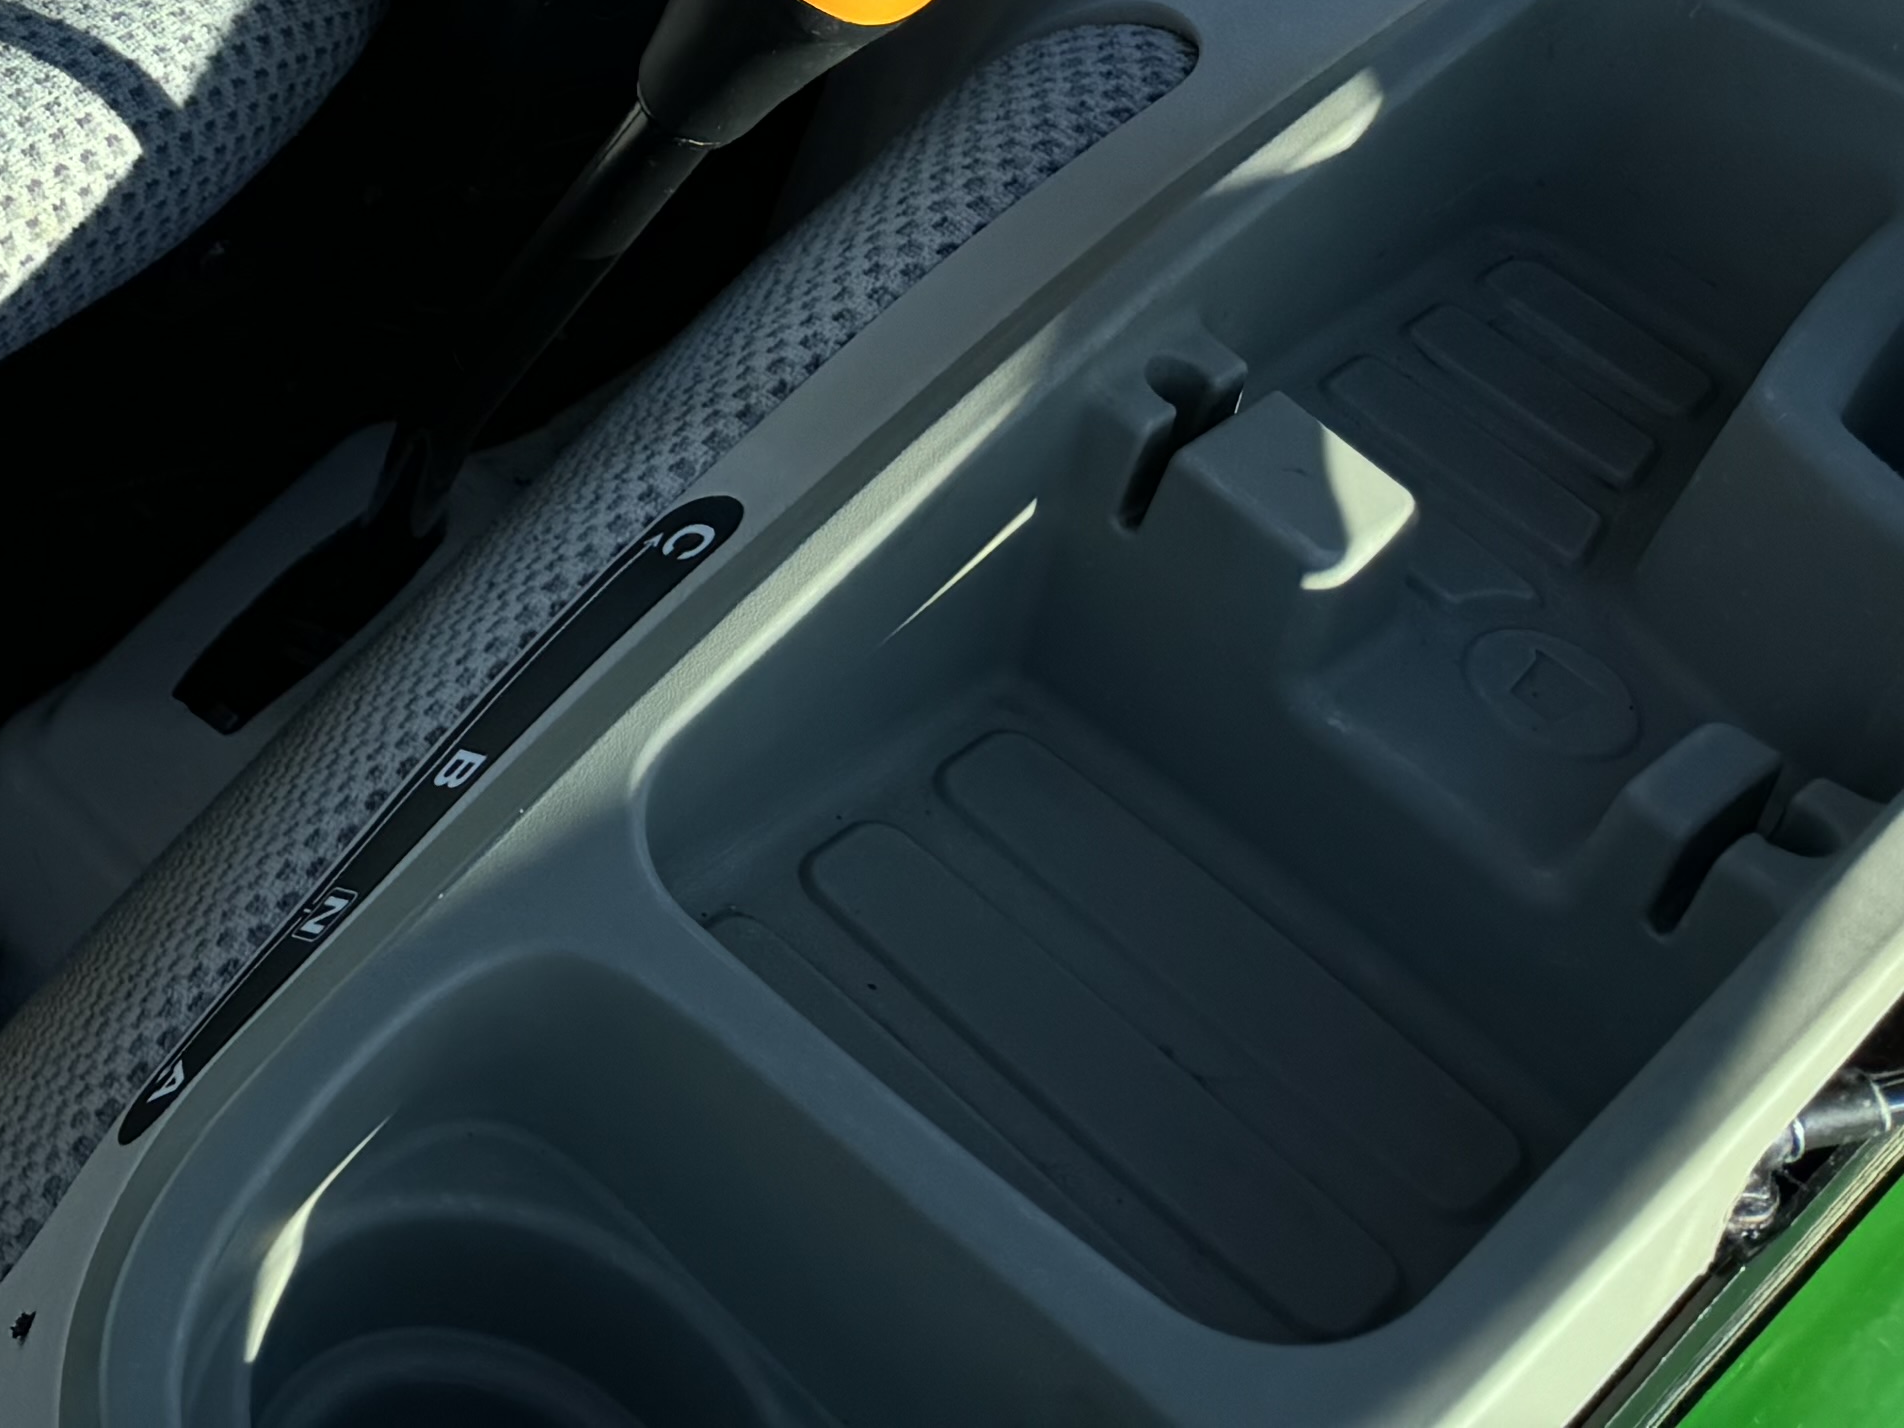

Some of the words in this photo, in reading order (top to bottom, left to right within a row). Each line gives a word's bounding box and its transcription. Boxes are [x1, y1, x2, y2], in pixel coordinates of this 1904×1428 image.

[662, 523, 716, 556] C
[434, 749, 488, 789] B
[299, 895, 350, 935] N
[145, 1059, 185, 1104] A
